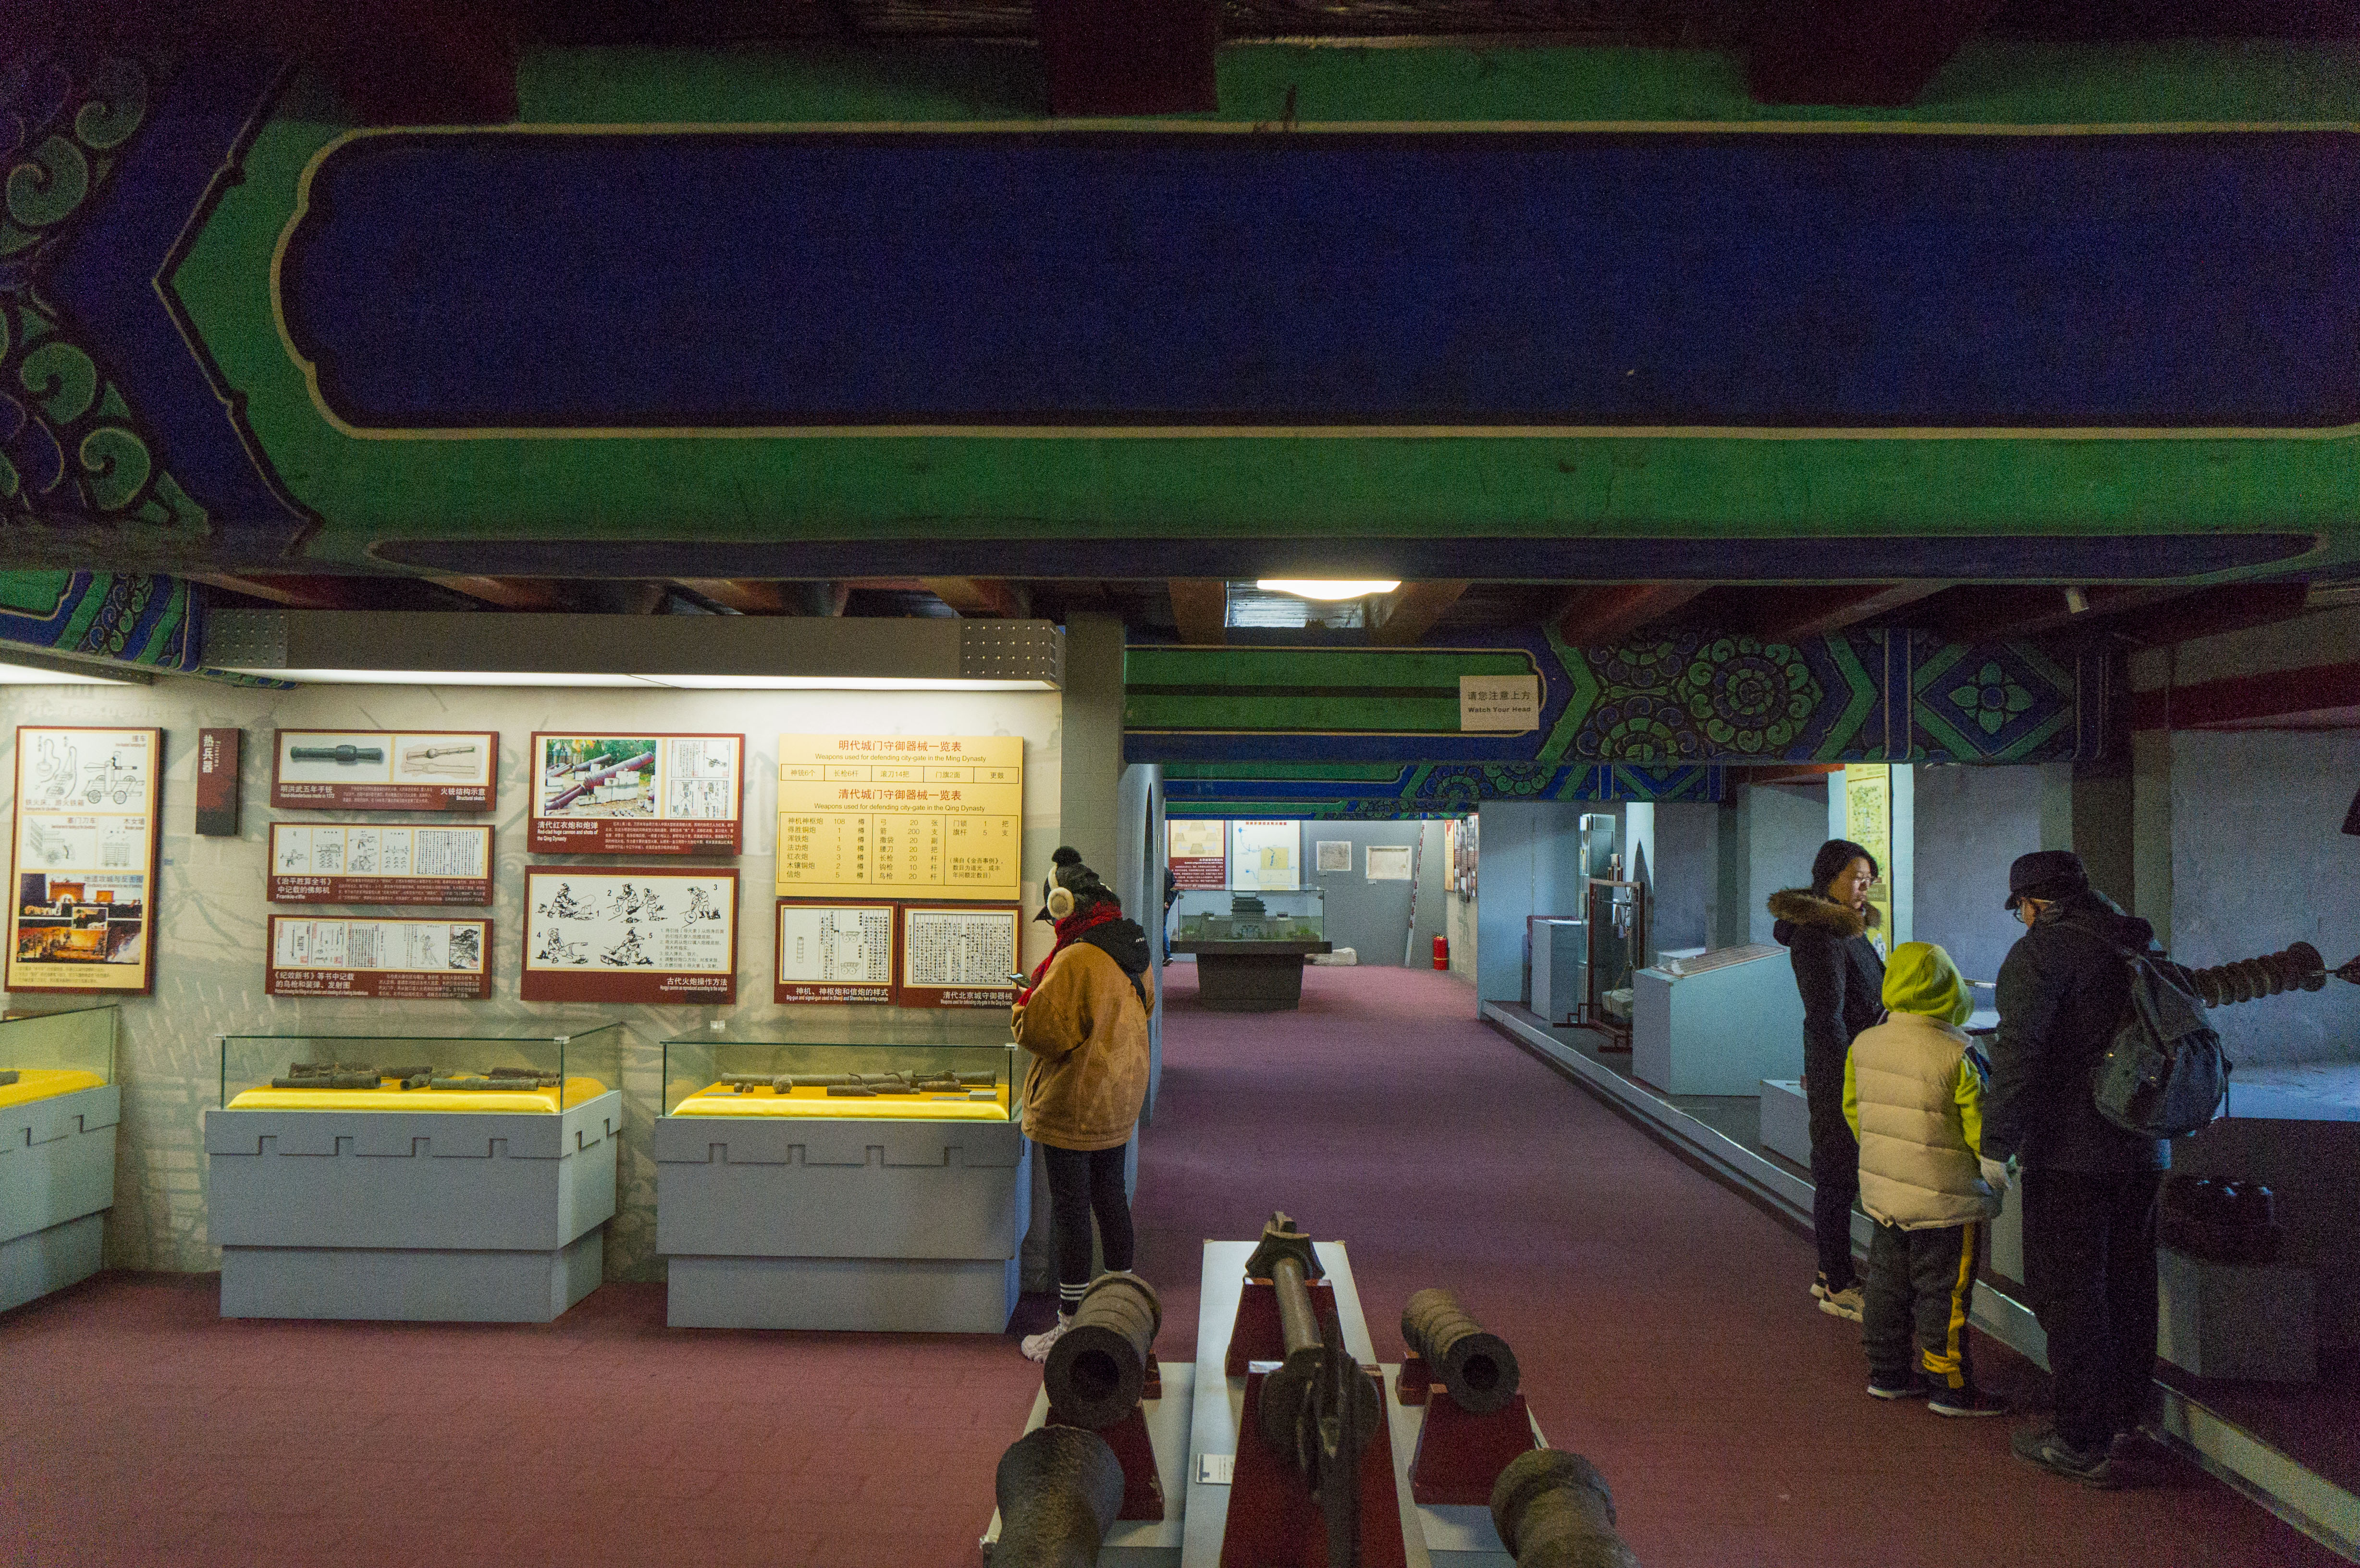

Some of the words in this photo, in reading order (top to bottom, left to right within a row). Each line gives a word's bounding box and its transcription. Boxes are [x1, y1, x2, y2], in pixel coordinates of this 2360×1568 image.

[1468, 691, 1531, 700] 请您注意上方
[838, 740, 962, 752] 明代城门守御器械一览表
[202, 735, 214, 773] 热兵器
[281, 785, 333, 793] 明洪武五年手铳
[441, 787, 486, 796] 火铳结构示意
[838, 789, 961, 800] 清代城门守御器械一览表
[538, 821, 598, 829] 清代红衣炮和炮弹
[277, 877, 332, 885] 《治平胜算全书》
[667, 977, 727, 986] 古代火炮操作方法
[796, 987, 888, 996] 神机、神枢炮和信炮的样式
[943, 992, 1013, 1000] 清代北京城守御器械
